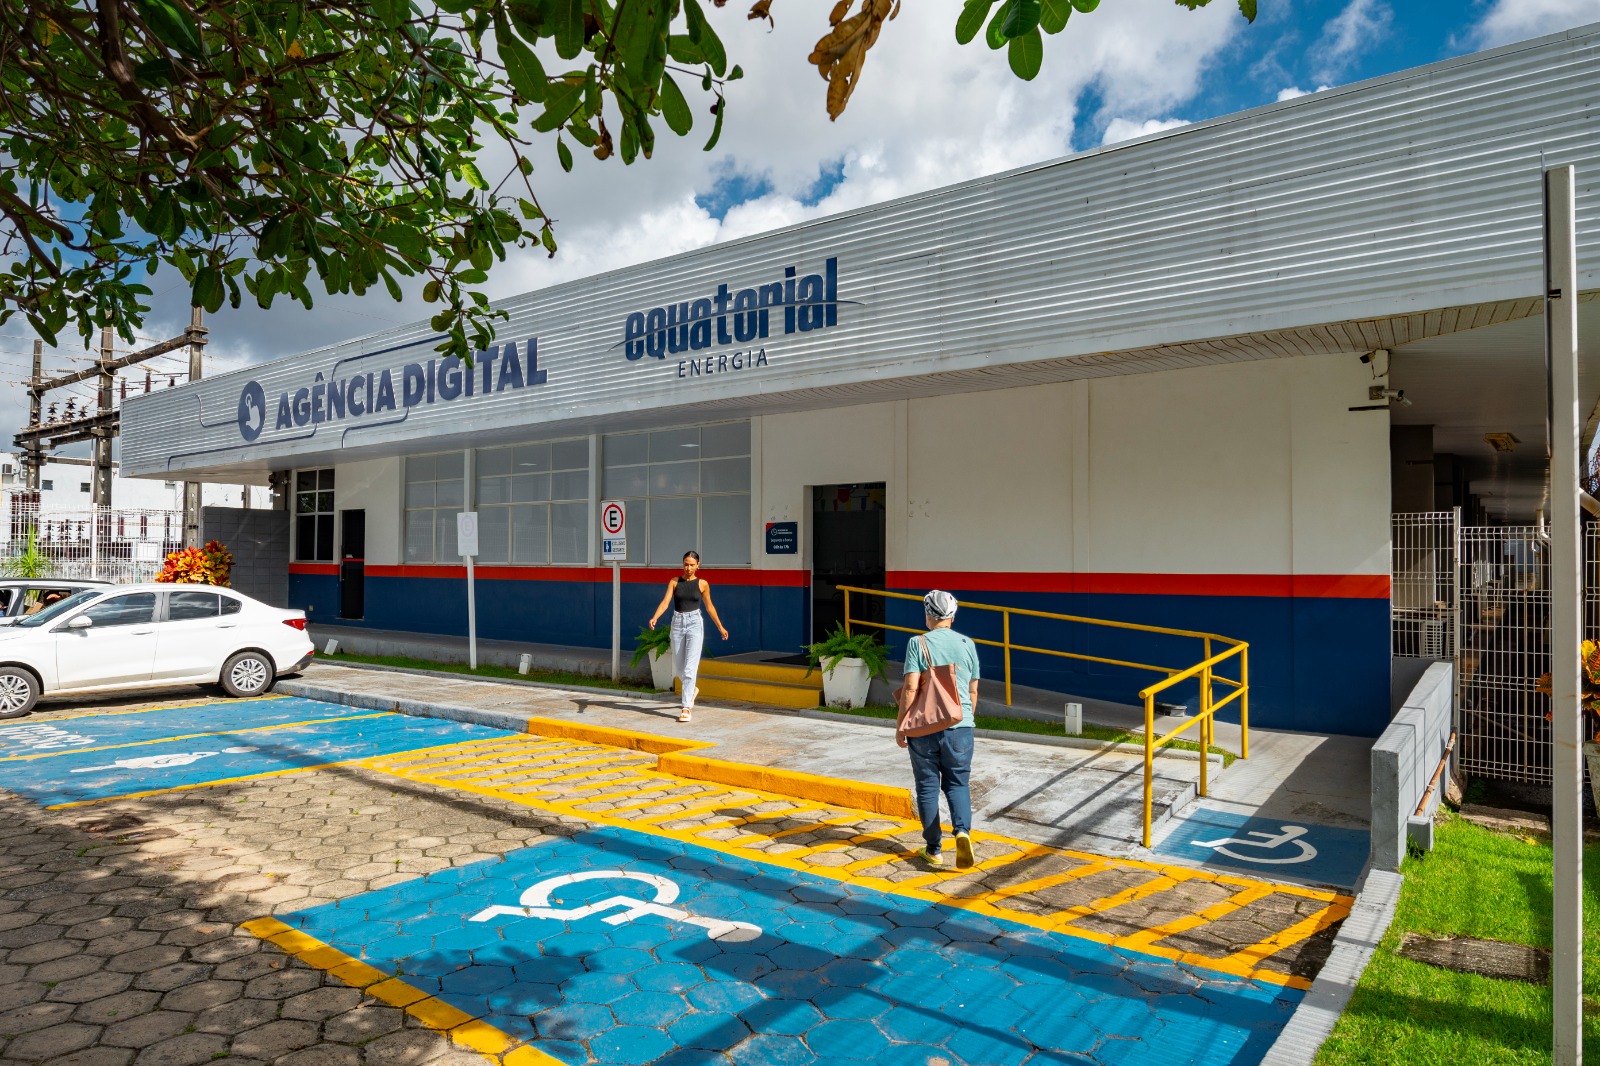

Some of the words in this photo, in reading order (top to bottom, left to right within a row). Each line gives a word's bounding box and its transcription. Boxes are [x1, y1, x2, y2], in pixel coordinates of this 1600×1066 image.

[625, 257, 838, 361] equatorial
[276, 372, 397, 430] AGÊNCIA
[402, 337, 548, 407] DIGITAL
[679, 349, 769, 378] ENERGIA
[609, 511, 618, 527] E
